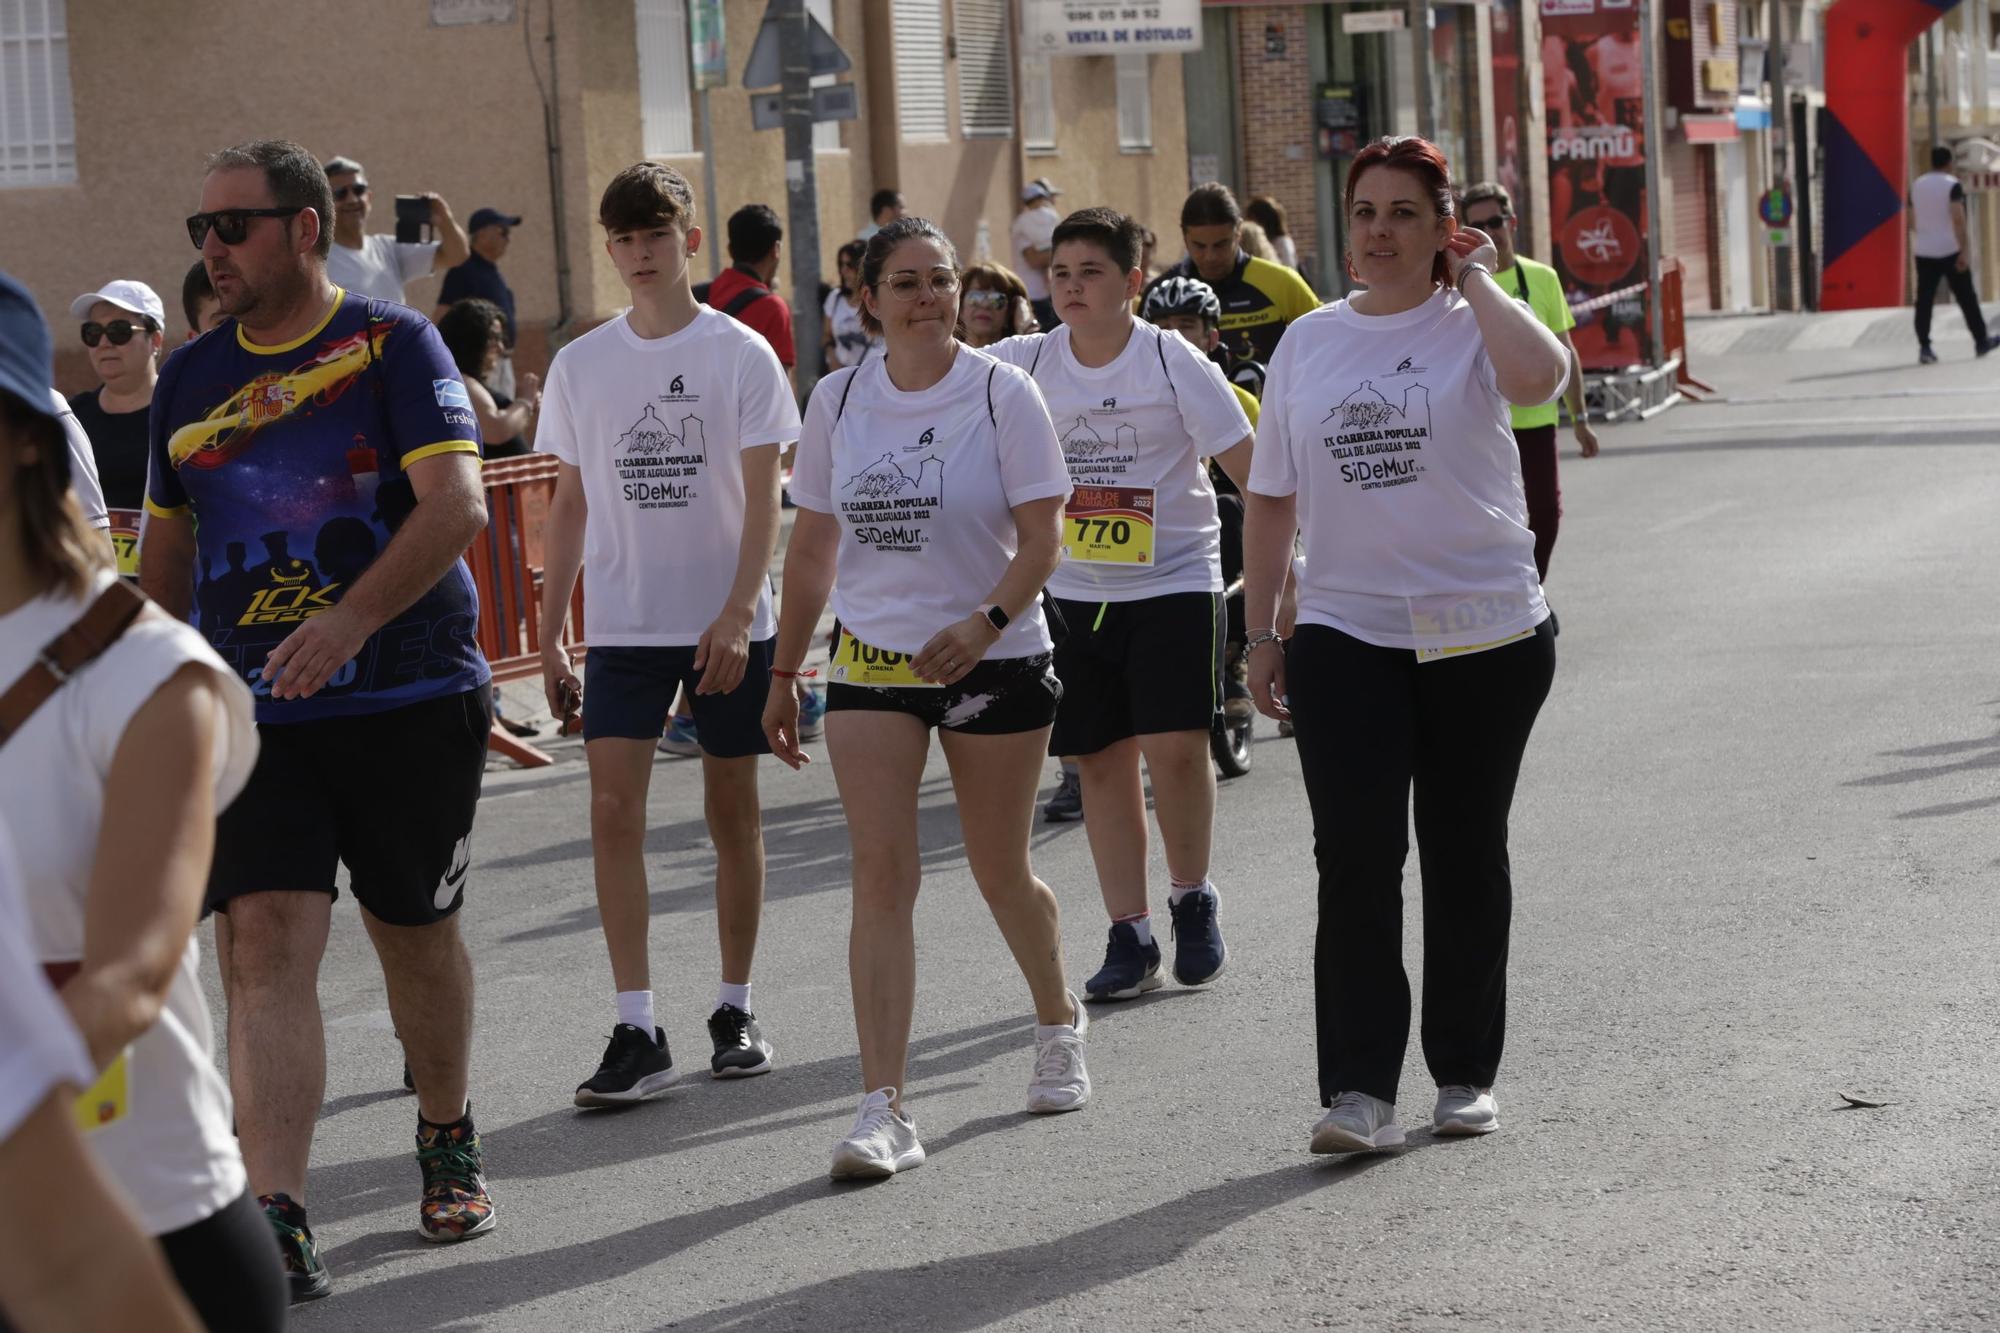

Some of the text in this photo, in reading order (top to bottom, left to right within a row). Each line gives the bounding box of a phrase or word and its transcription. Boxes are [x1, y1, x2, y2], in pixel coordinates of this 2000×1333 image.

[1067, 30, 1108, 44] VENTA
[1114, 29, 1128, 43] DE
[1324, 427, 1427, 448] IX CARRERA POPULAR
[1331, 446, 1356, 460] VILLA
[1355, 445, 1365, 457] DE
[1366, 441, 1403, 456] ALGUAZAS
[622, 457, 664, 468] CARRERA
[665, 454, 704, 466] POPULAR
[619, 466, 697, 479] VILLA DE ALGUAZAS 2022
[1340, 456, 1415, 483] SiDeMur
[623, 481, 689, 501] SiDeMur
[1361, 482, 1382, 491] CENTRO
[638, 502, 657, 510] CENTRO
[841, 496, 938, 512] IX CARRERA POPULAR
[1133, 500, 1151, 508] 2022
[846, 510, 930, 524] VILLA DE ALGUAZAS 2022
[854, 525, 921, 545] SiDeMur
[1075, 518, 1131, 545] 770
[850, 637, 913, 666] 100
[866, 664, 894, 672] LORENA
